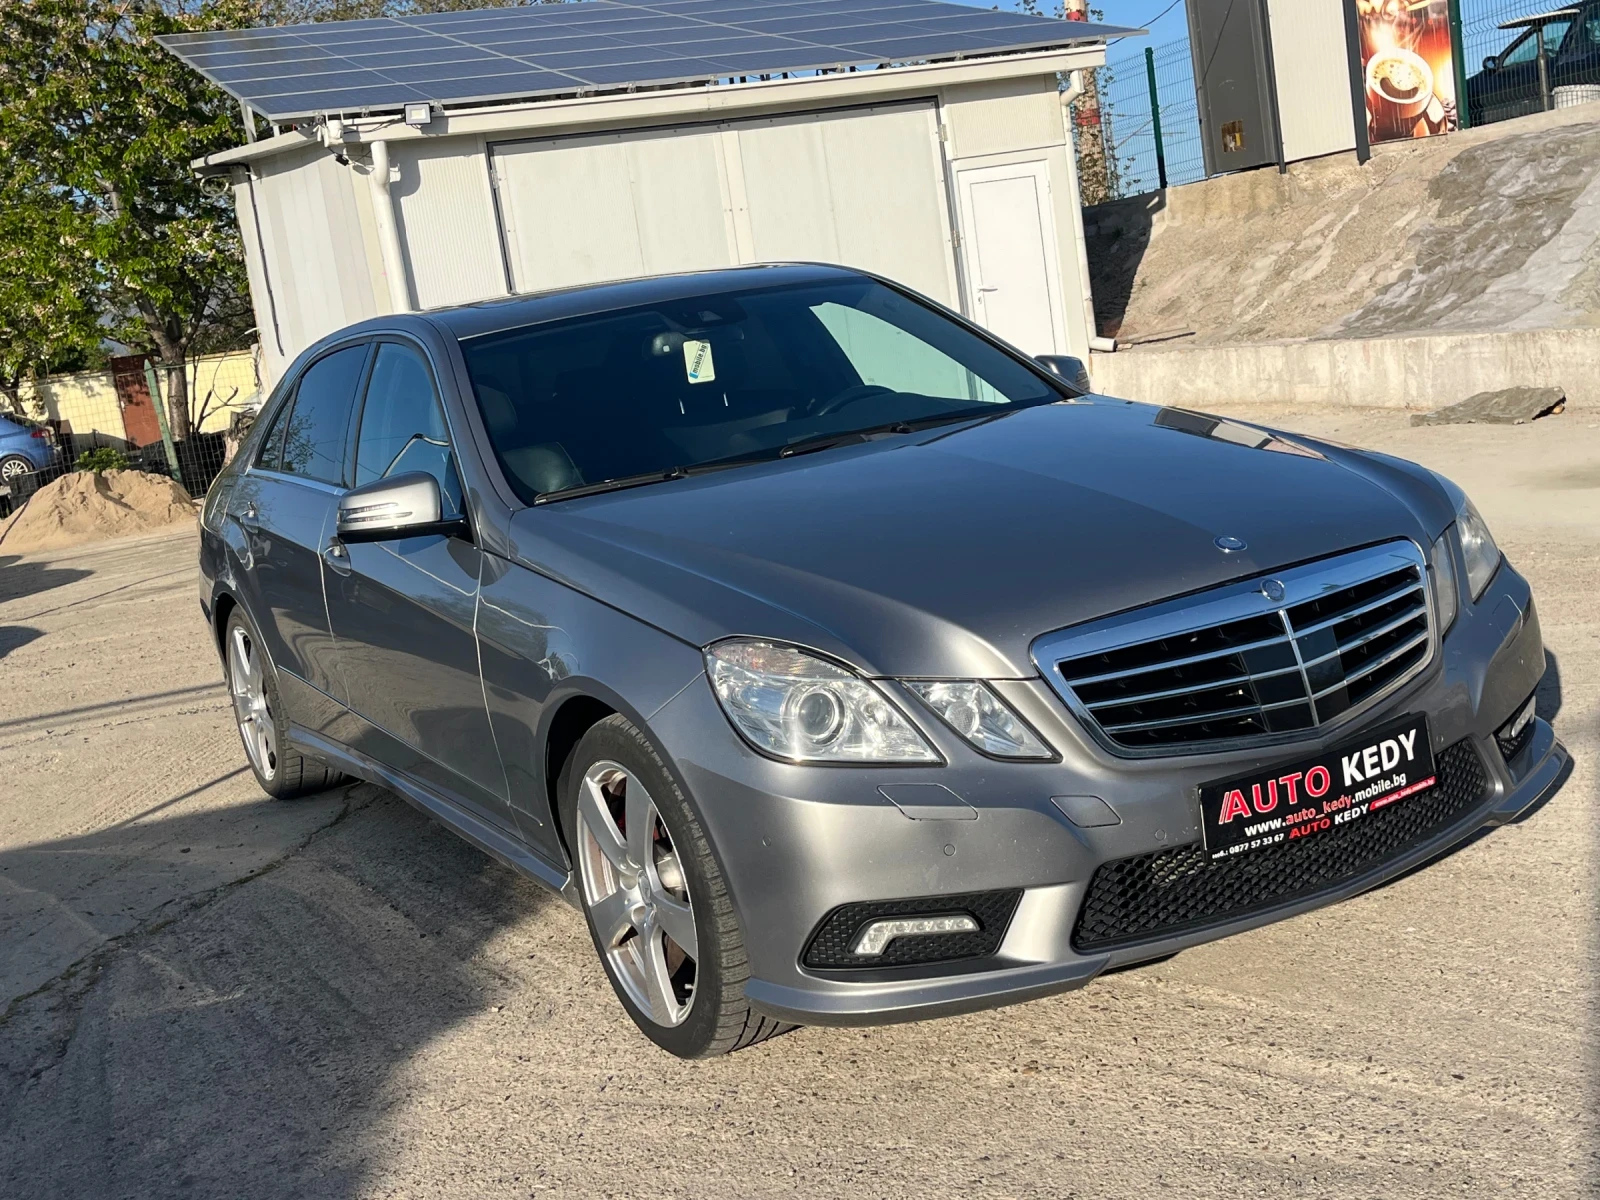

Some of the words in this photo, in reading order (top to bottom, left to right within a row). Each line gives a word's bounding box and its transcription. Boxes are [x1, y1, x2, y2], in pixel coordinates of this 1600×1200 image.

[1218, 765, 1331, 825] AUTO
[1341, 729, 1417, 787] KEDY
[1244, 772, 1407, 837] www.auto_kedy.mobile.bg
[1288, 818, 1330, 840] AUTO
[1334, 803, 1369, 825] KEDY
[1229, 842, 1249, 854] 0877
[1250, 839, 1261, 849] 57
[1262, 836, 1273, 846] 33
[1274, 833, 1284, 842] 67
